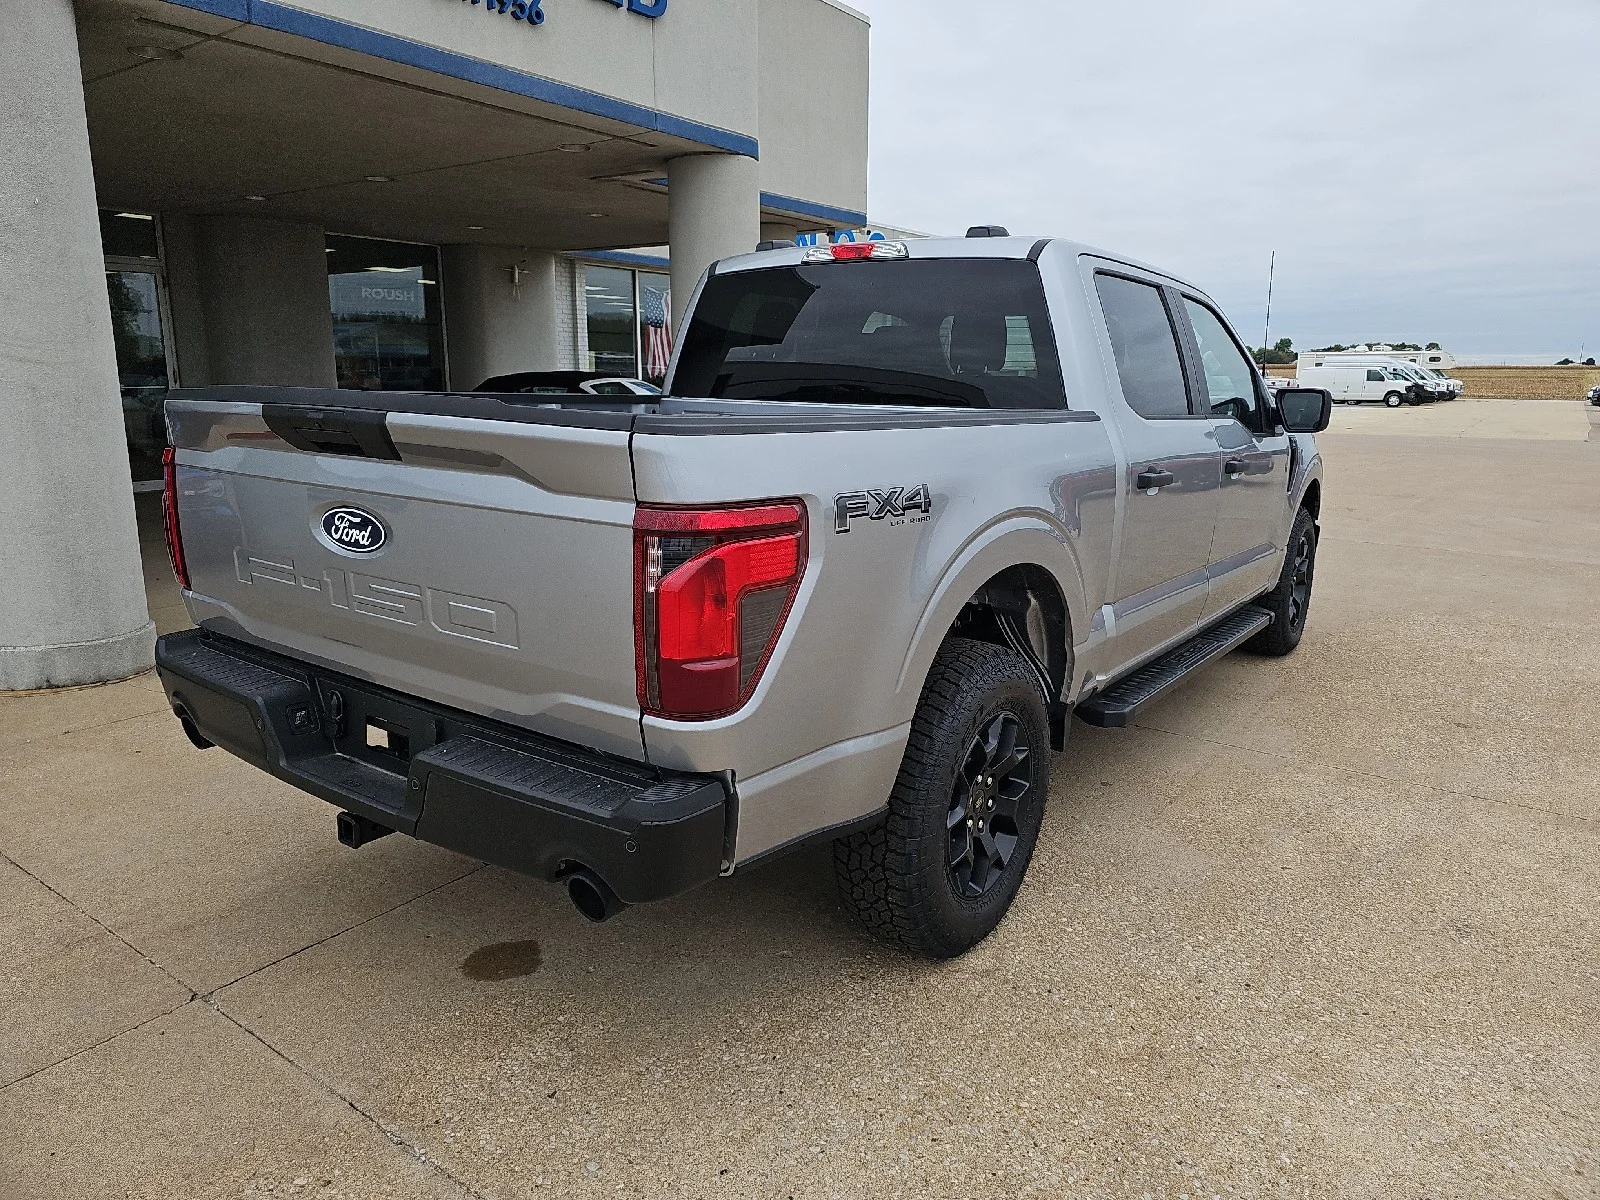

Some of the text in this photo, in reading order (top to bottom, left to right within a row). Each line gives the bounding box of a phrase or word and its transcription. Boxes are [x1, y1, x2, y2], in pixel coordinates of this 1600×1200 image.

[361, 287, 415, 302] ROUSH
[331, 512, 372, 546] Ford
[833, 483, 931, 535] FX4
[233, 546, 520, 650] F-150
